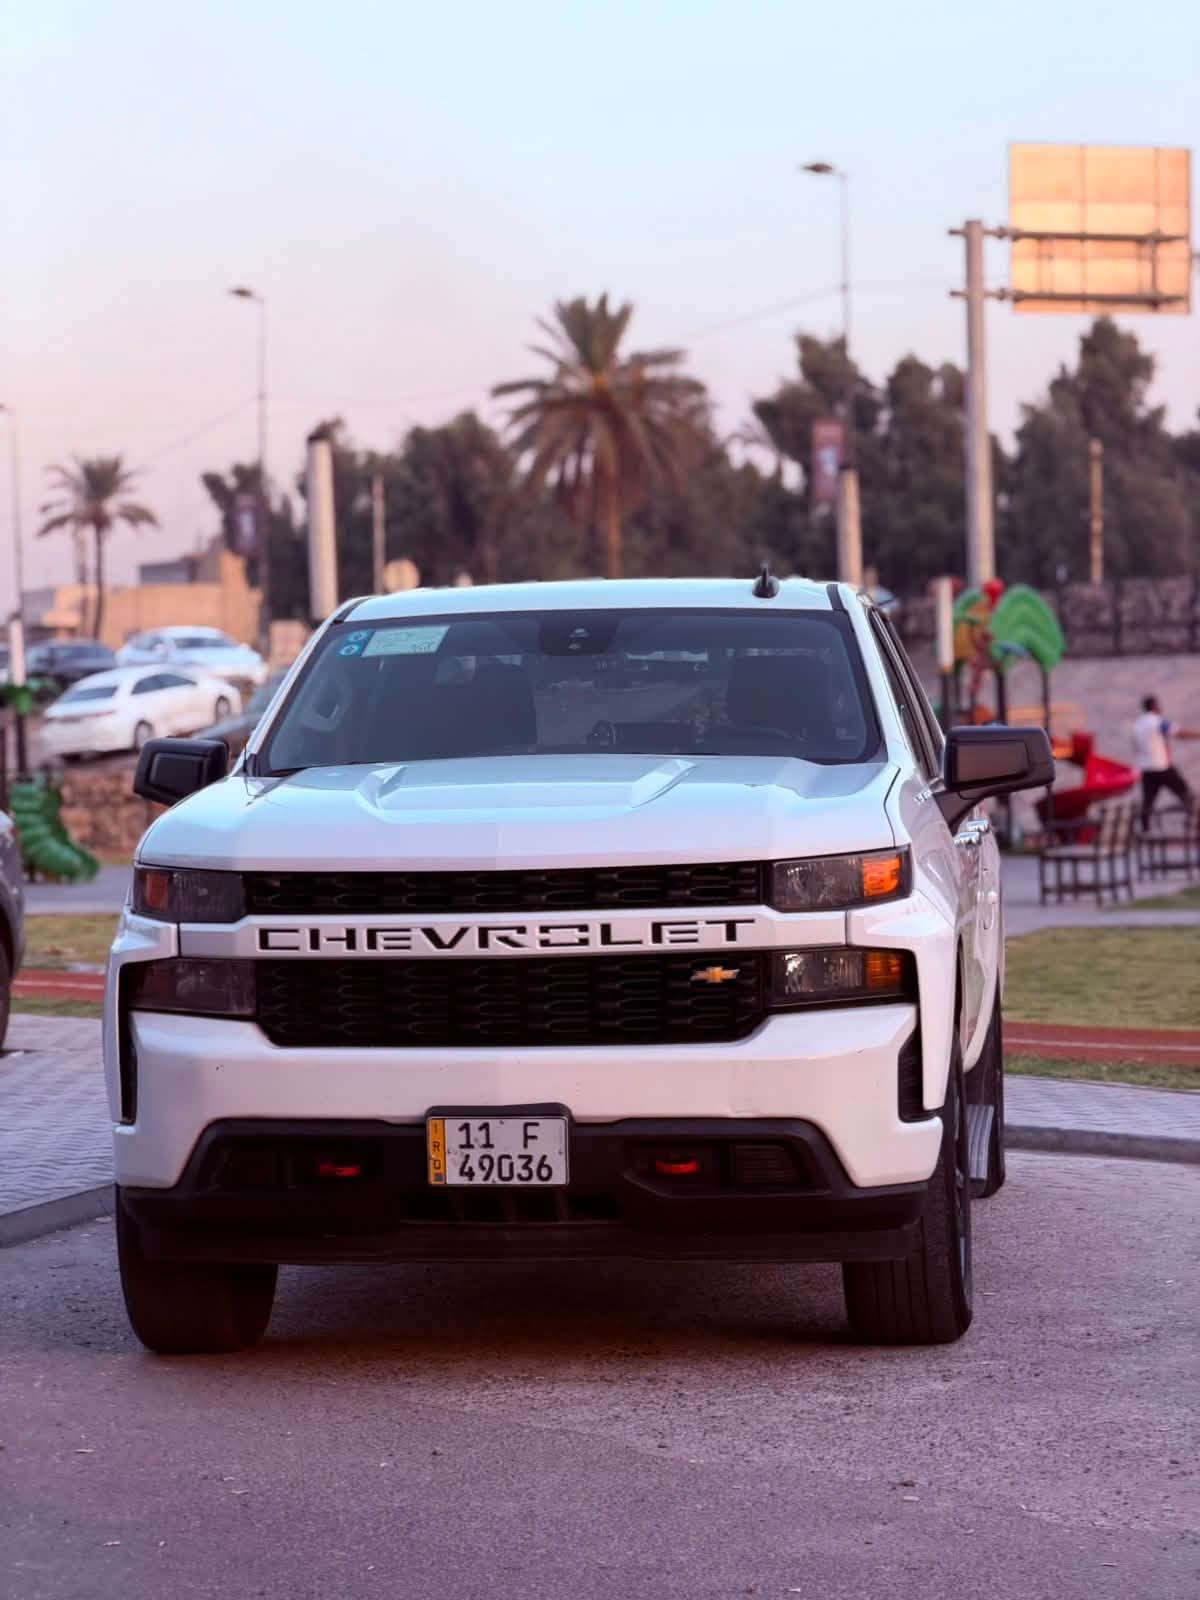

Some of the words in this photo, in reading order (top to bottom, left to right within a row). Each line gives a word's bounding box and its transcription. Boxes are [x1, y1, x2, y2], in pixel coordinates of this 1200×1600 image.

[258, 918, 756, 951] CHEVROLET
[458, 1122, 495, 1149] 11
[523, 1122, 540, 1149] F
[458, 1154, 553, 1182] 49036
